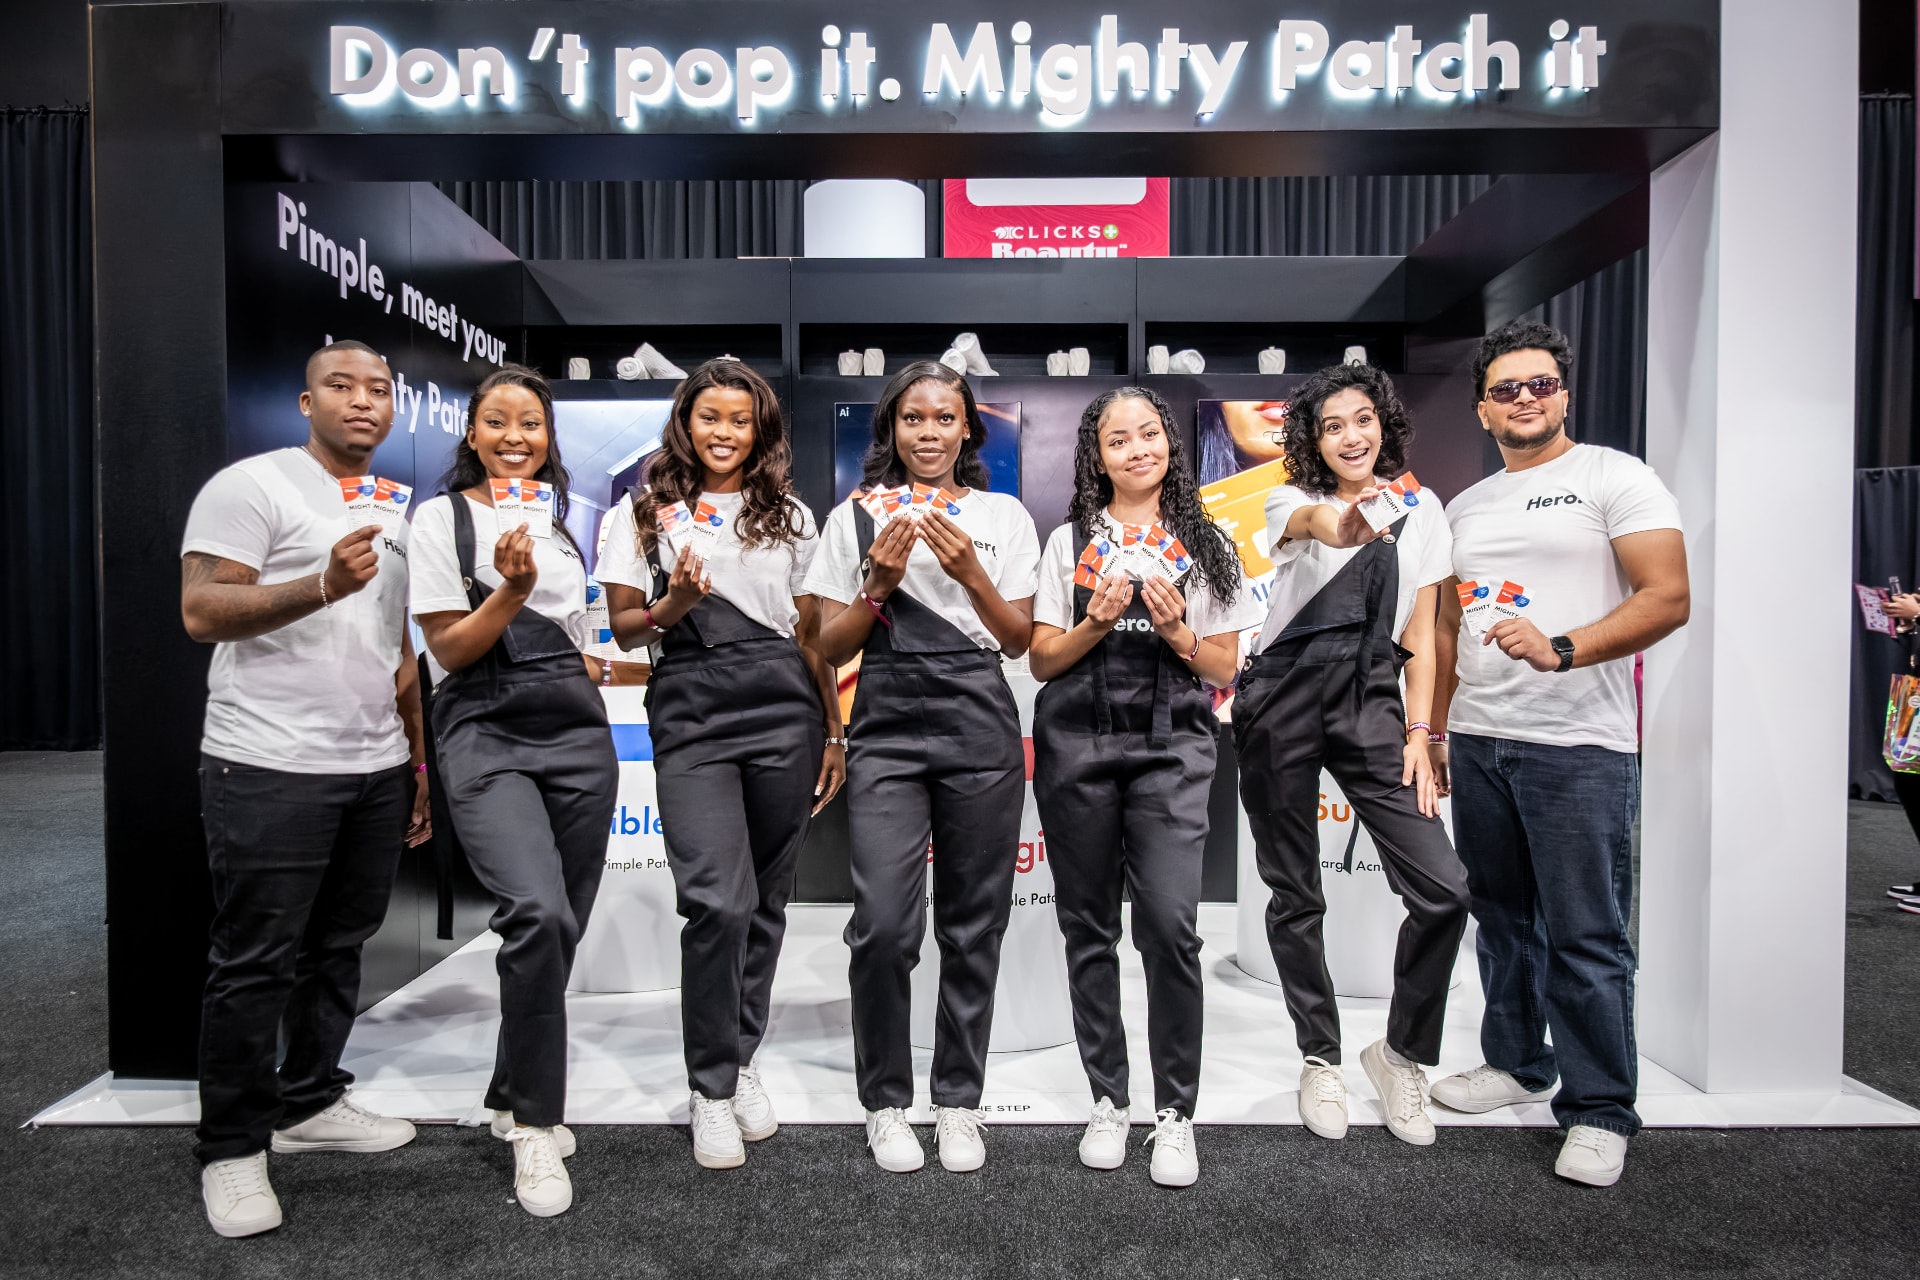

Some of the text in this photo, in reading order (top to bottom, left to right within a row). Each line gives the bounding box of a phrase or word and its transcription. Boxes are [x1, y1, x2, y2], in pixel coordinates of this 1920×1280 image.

[615, 46, 789, 119] pop
[820, 24, 901, 101] it.
[922, 14, 1249, 115] Mighty
[1279, 14, 1520, 93] Patch
[1547, 19, 1607, 90] it
[1010, 226, 1102, 240] CLICKS
[278, 191, 507, 367] Pimple, meet your
[348, 503, 371, 511] MIGHT
[373, 503, 400, 516] MIGHTY
[523, 505, 548, 514] MIGHTY
[1381, 491, 1401, 514] MIGHTY
[1526, 494, 1583, 511] Hero.
[1102, 555, 1119, 576] MIGHTY
[1157, 558, 1174, 579] MIGHTY
[1465, 603, 1491, 615] MIGHTY
[1494, 605, 1520, 619] MIGHTY
[1113, 618, 1155, 632] ero.
[996, 1104, 1031, 1112] STEP
